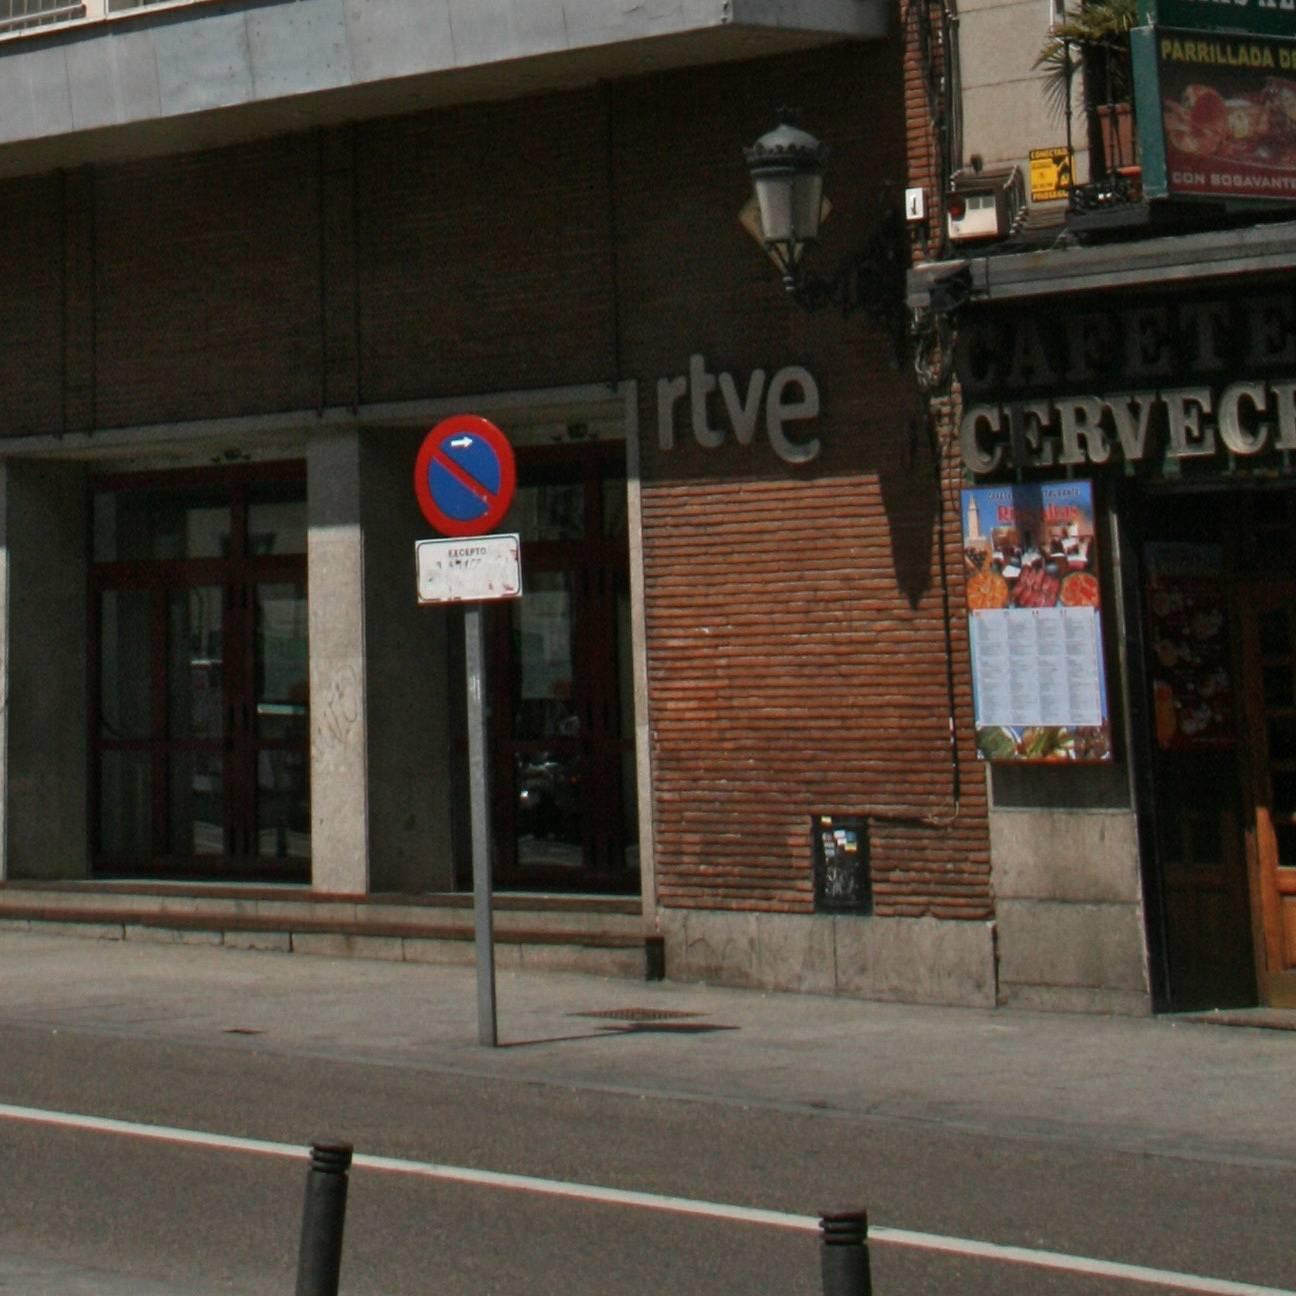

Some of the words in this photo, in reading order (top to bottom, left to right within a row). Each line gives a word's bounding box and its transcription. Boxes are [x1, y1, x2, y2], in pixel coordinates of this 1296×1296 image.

[1161, 38, 1275, 68] PARRILLADA
[1171, 171, 1206, 185] CON
[657, 353, 821, 464] rtve
[448, 547, 487, 558] EXCEPTO
